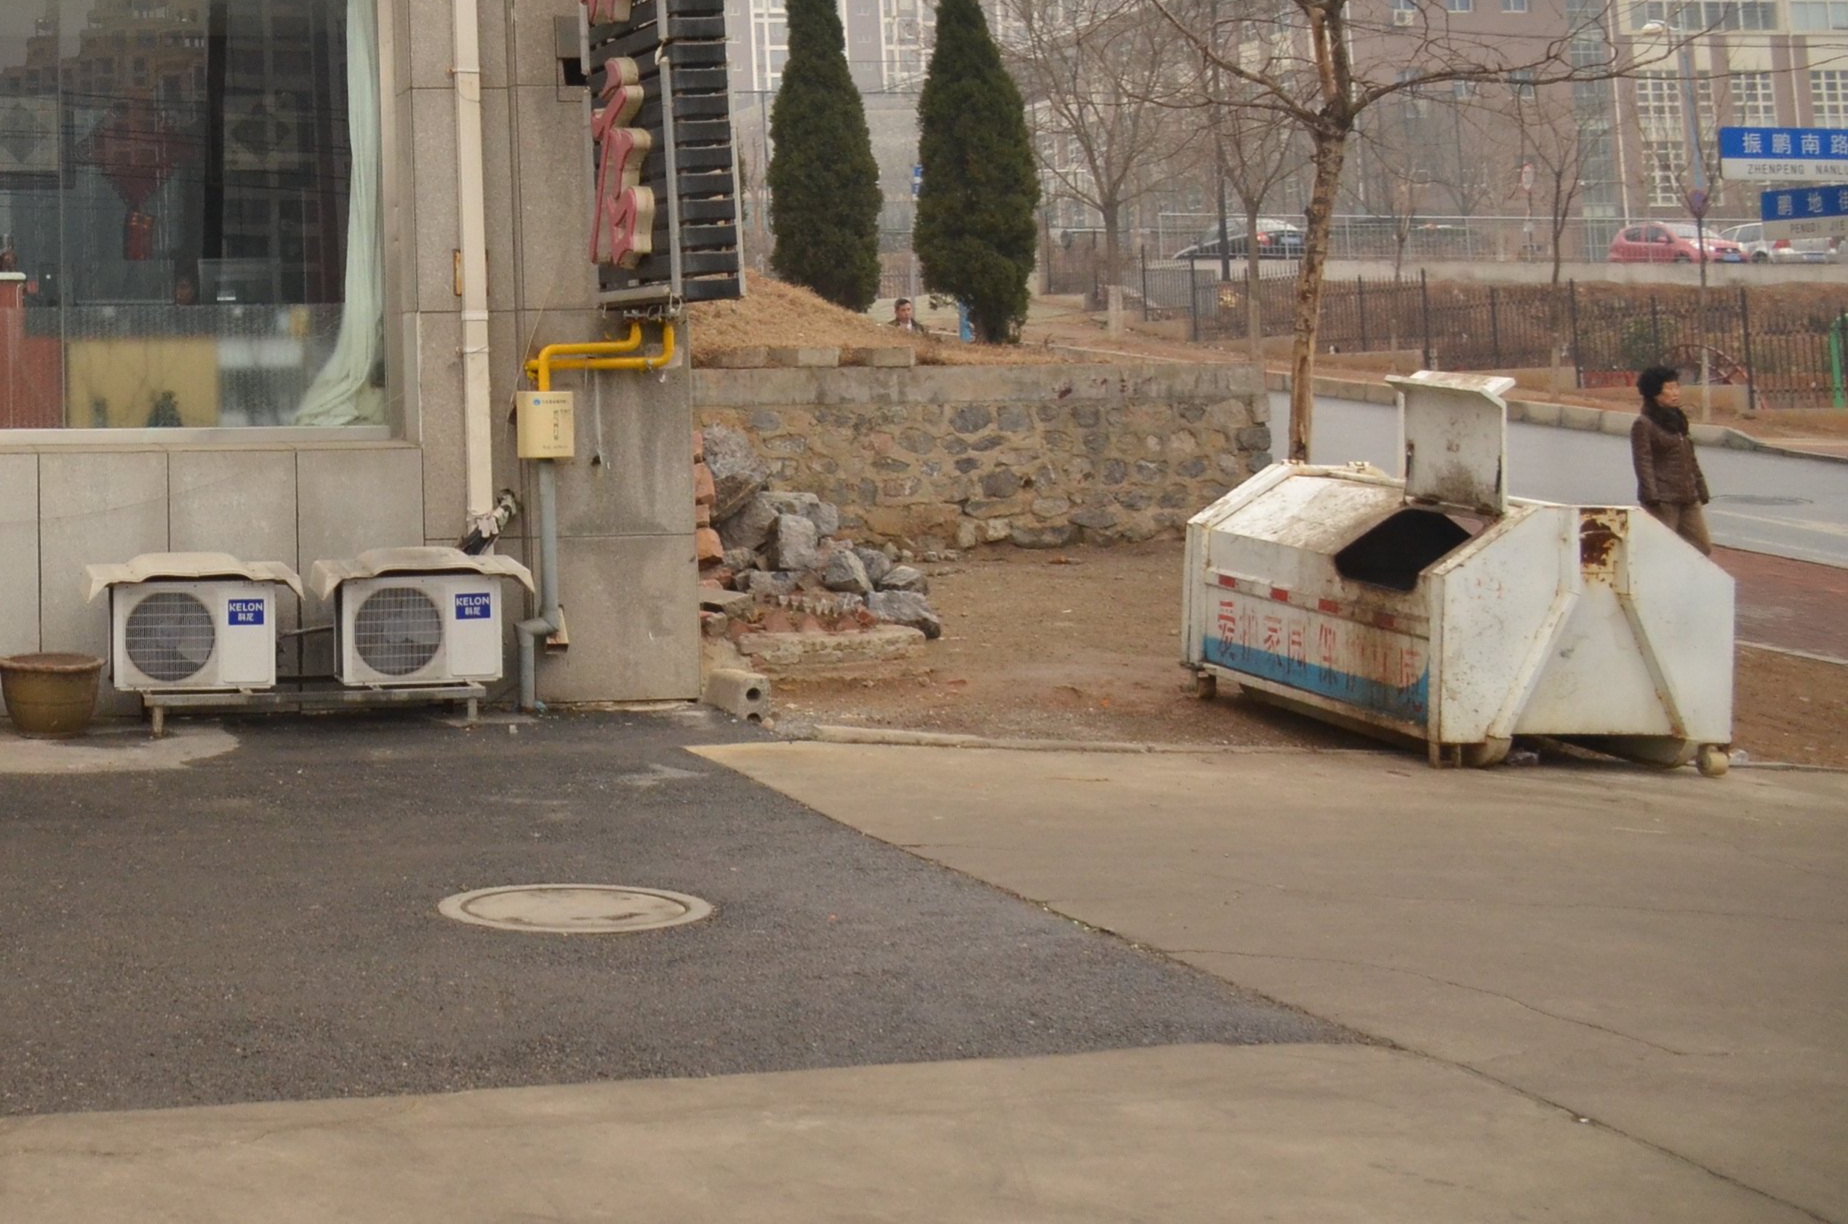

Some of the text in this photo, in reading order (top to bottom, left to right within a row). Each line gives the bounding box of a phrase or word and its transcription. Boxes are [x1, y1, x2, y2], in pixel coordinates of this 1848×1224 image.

[1742, 132, 1848, 155] 振鹏南路
[1747, 163, 1805, 175] ZHENPENG
[456, 596, 490, 606] KELON
[229, 602, 264, 612] KELON
